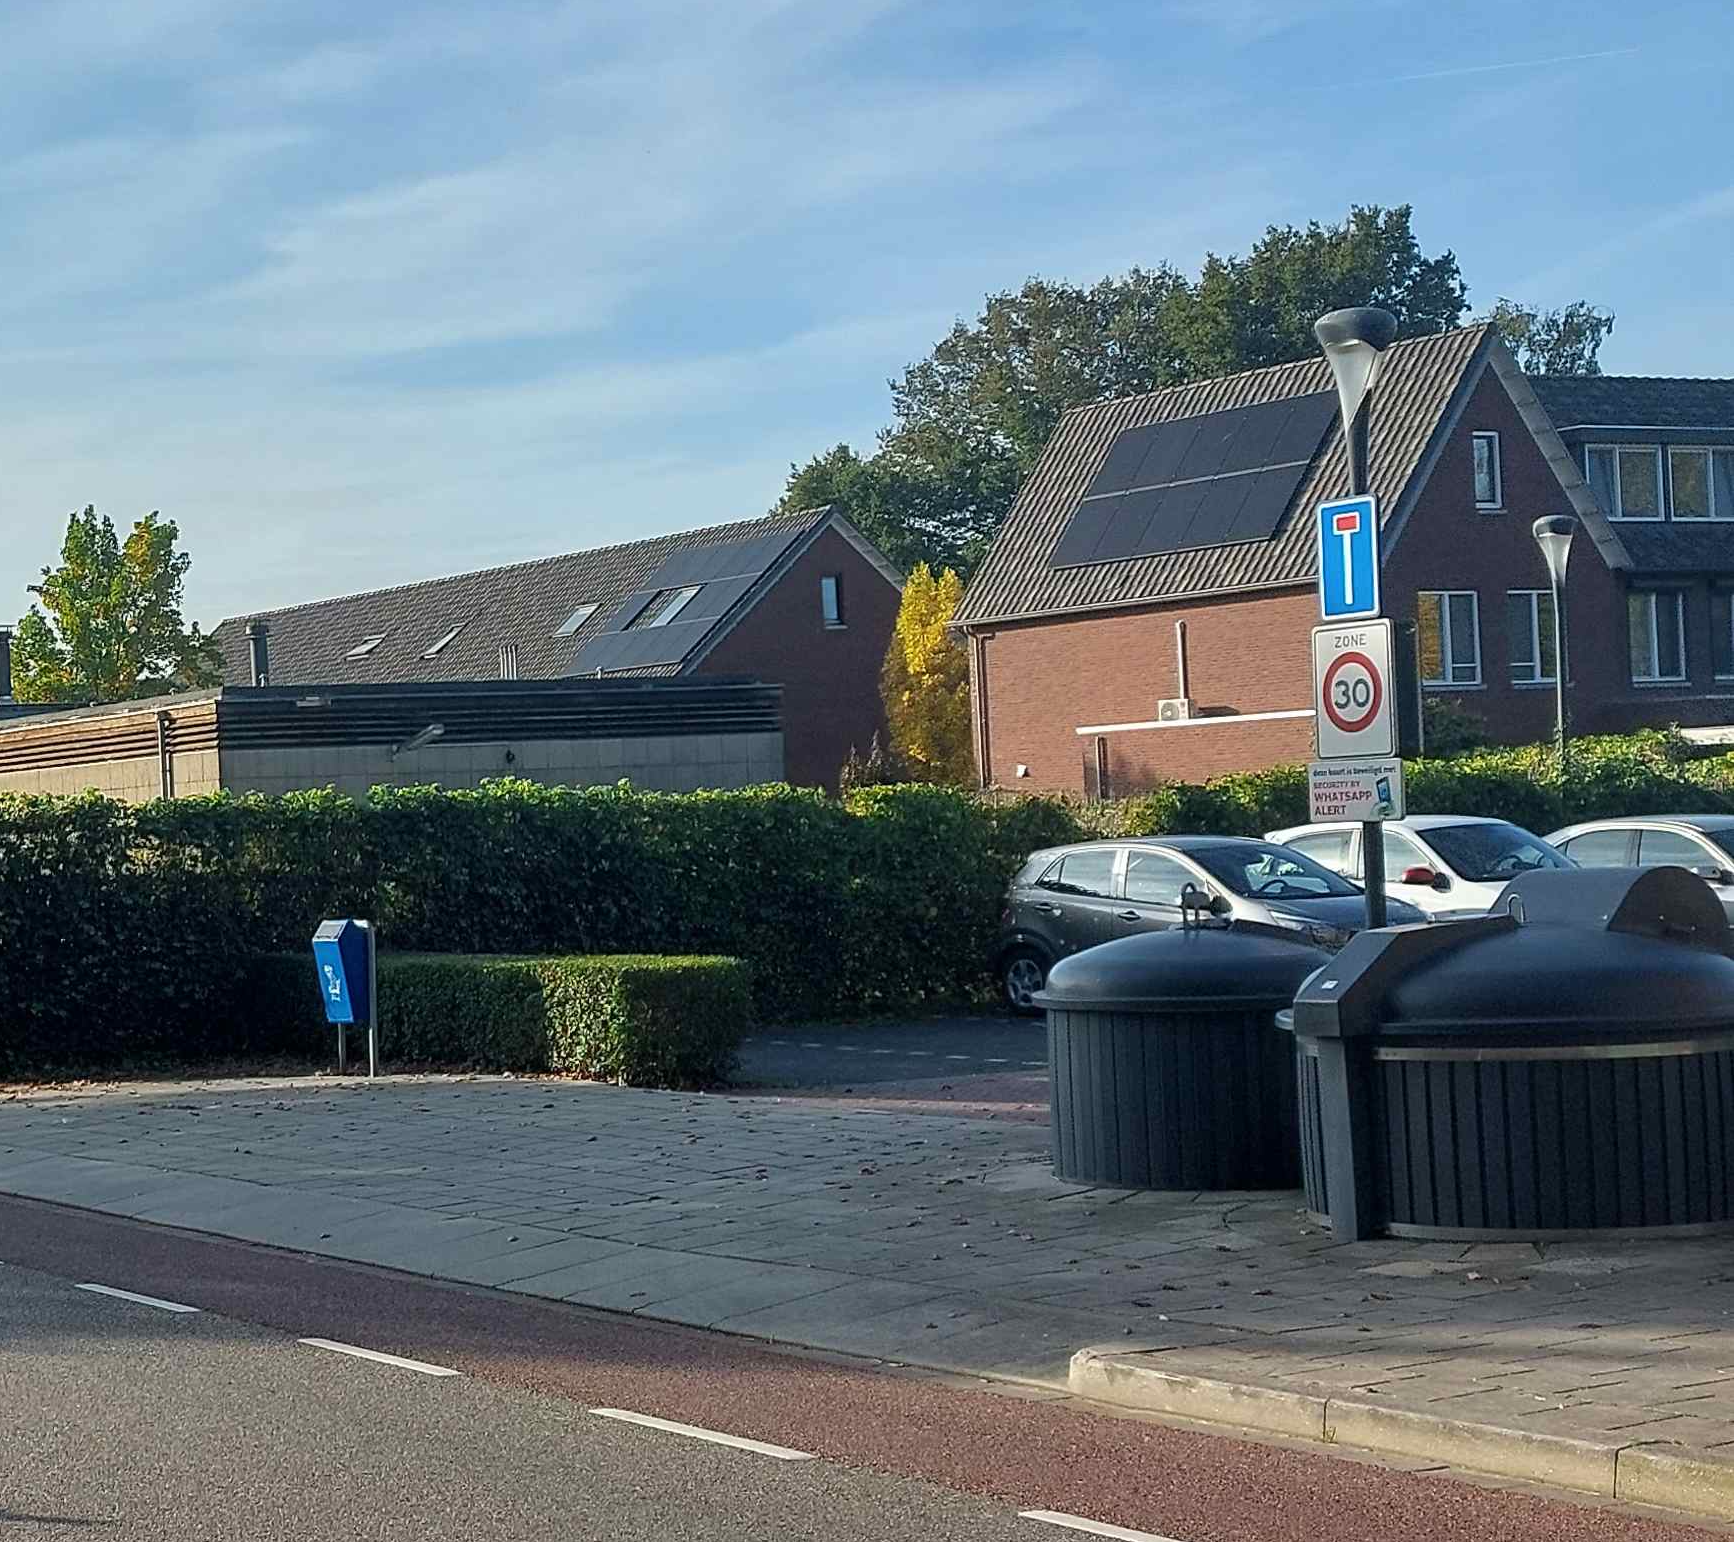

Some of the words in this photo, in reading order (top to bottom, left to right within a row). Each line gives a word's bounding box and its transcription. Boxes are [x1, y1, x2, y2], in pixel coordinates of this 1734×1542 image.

[1334, 633, 1367, 648] ZONE
[1334, 678, 1371, 710] 30
[1314, 790, 1372, 802] WHATSAPP
[1314, 804, 1347, 816] ALERT
